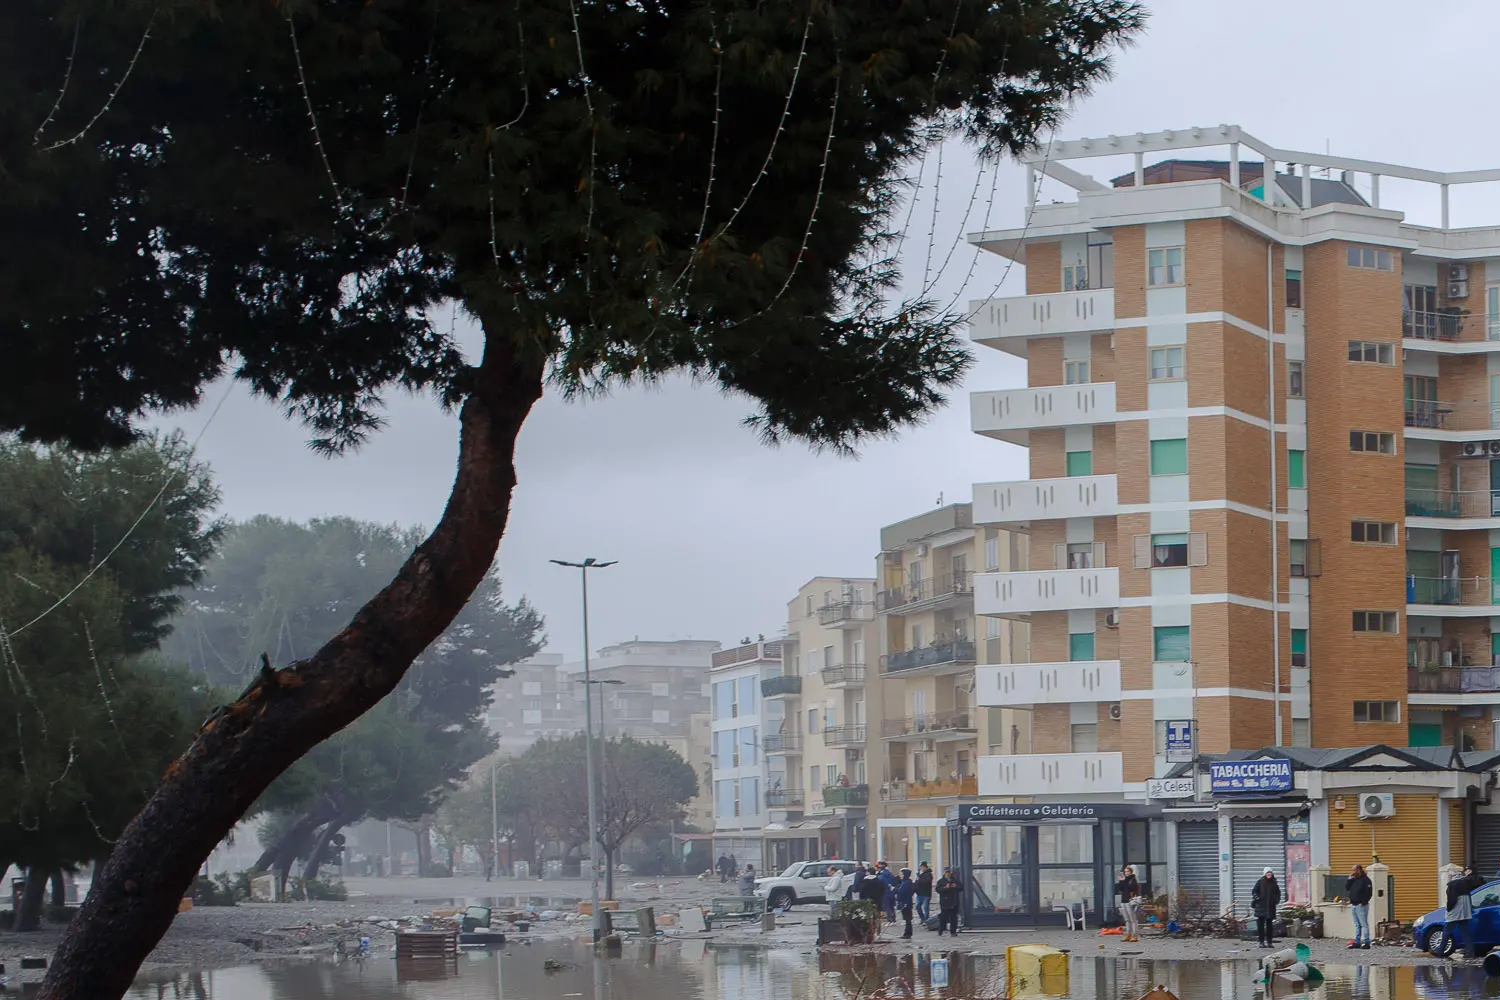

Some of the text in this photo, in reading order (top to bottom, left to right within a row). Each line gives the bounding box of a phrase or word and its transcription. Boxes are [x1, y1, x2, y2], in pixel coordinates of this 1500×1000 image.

[1169, 721, 1189, 740] T
[1211, 763, 1290, 777] TABACCHERIA
[969, 805, 1094, 816] Caffetteria Gelateria
